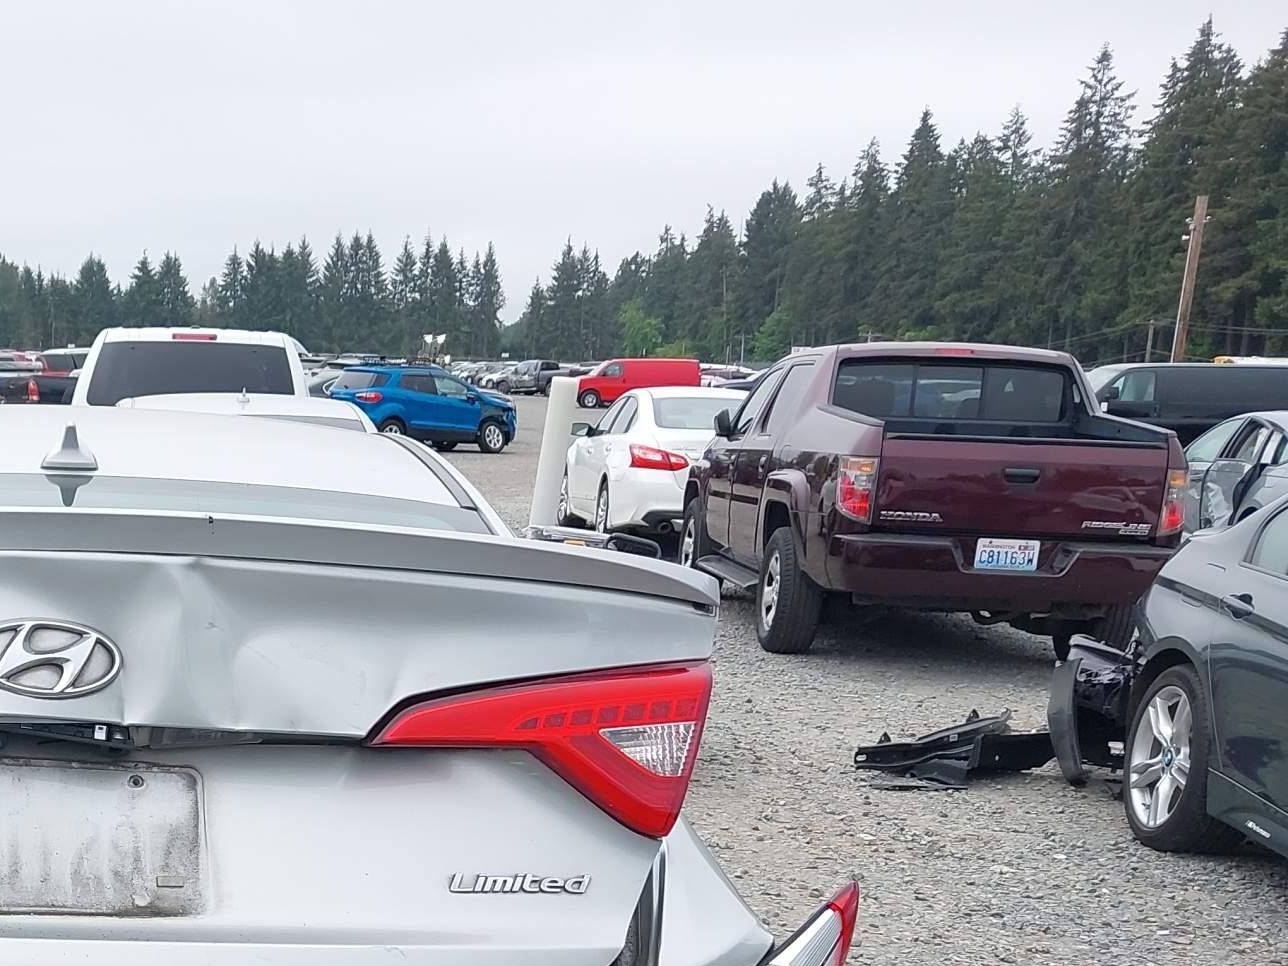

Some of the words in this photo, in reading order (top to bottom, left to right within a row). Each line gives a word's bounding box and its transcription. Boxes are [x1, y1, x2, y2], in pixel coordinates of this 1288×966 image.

[879, 510, 943, 522] HONDA
[978, 549, 1035, 566] C81163W
[448, 871, 592, 895] Limited
